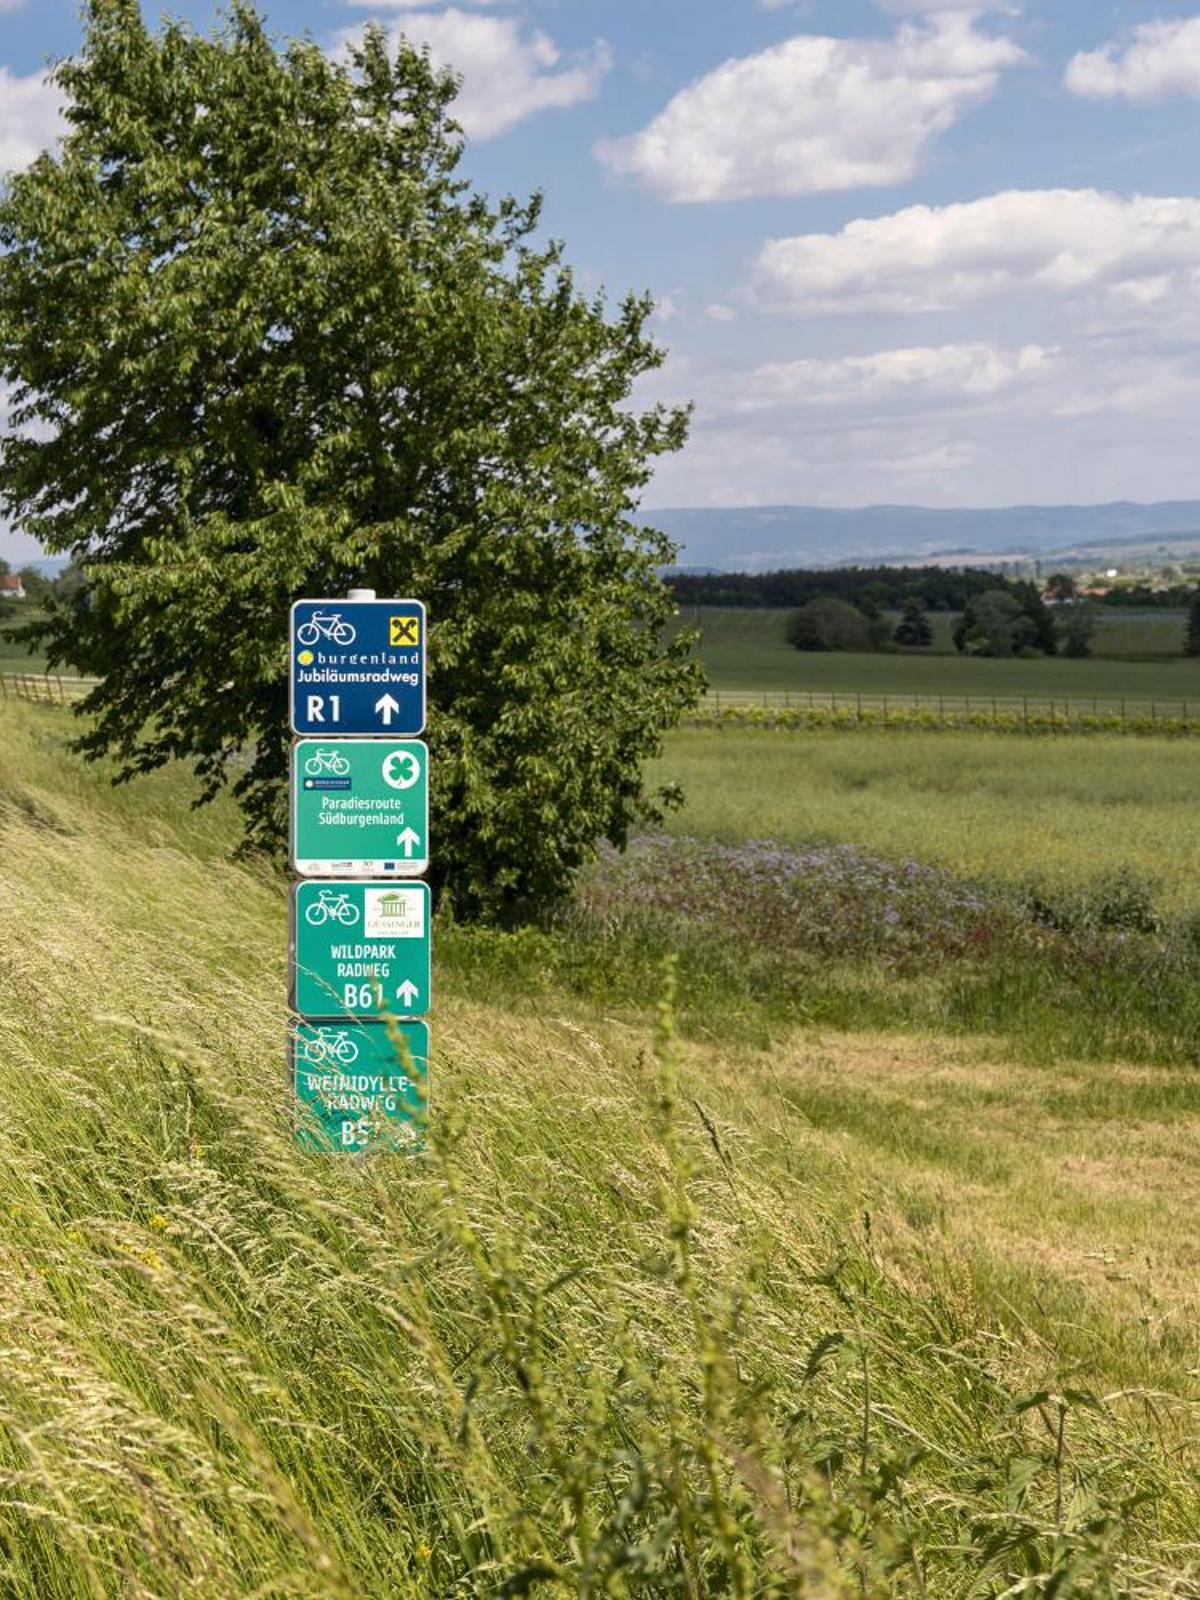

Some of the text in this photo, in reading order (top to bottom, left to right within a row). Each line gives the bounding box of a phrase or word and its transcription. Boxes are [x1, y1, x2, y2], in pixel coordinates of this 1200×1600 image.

[317, 652, 419, 665] burgenland
[297, 668, 419, 687] Jubiläumsradweg
[307, 695, 340, 722] R1
[322, 797, 401, 810] Paradiesroute
[318, 812, 404, 828] Südburgenland
[331, 945, 396, 959] WILDPARK
[337, 963, 390, 977] RADWEG
[344, 984, 384, 1008] B61
